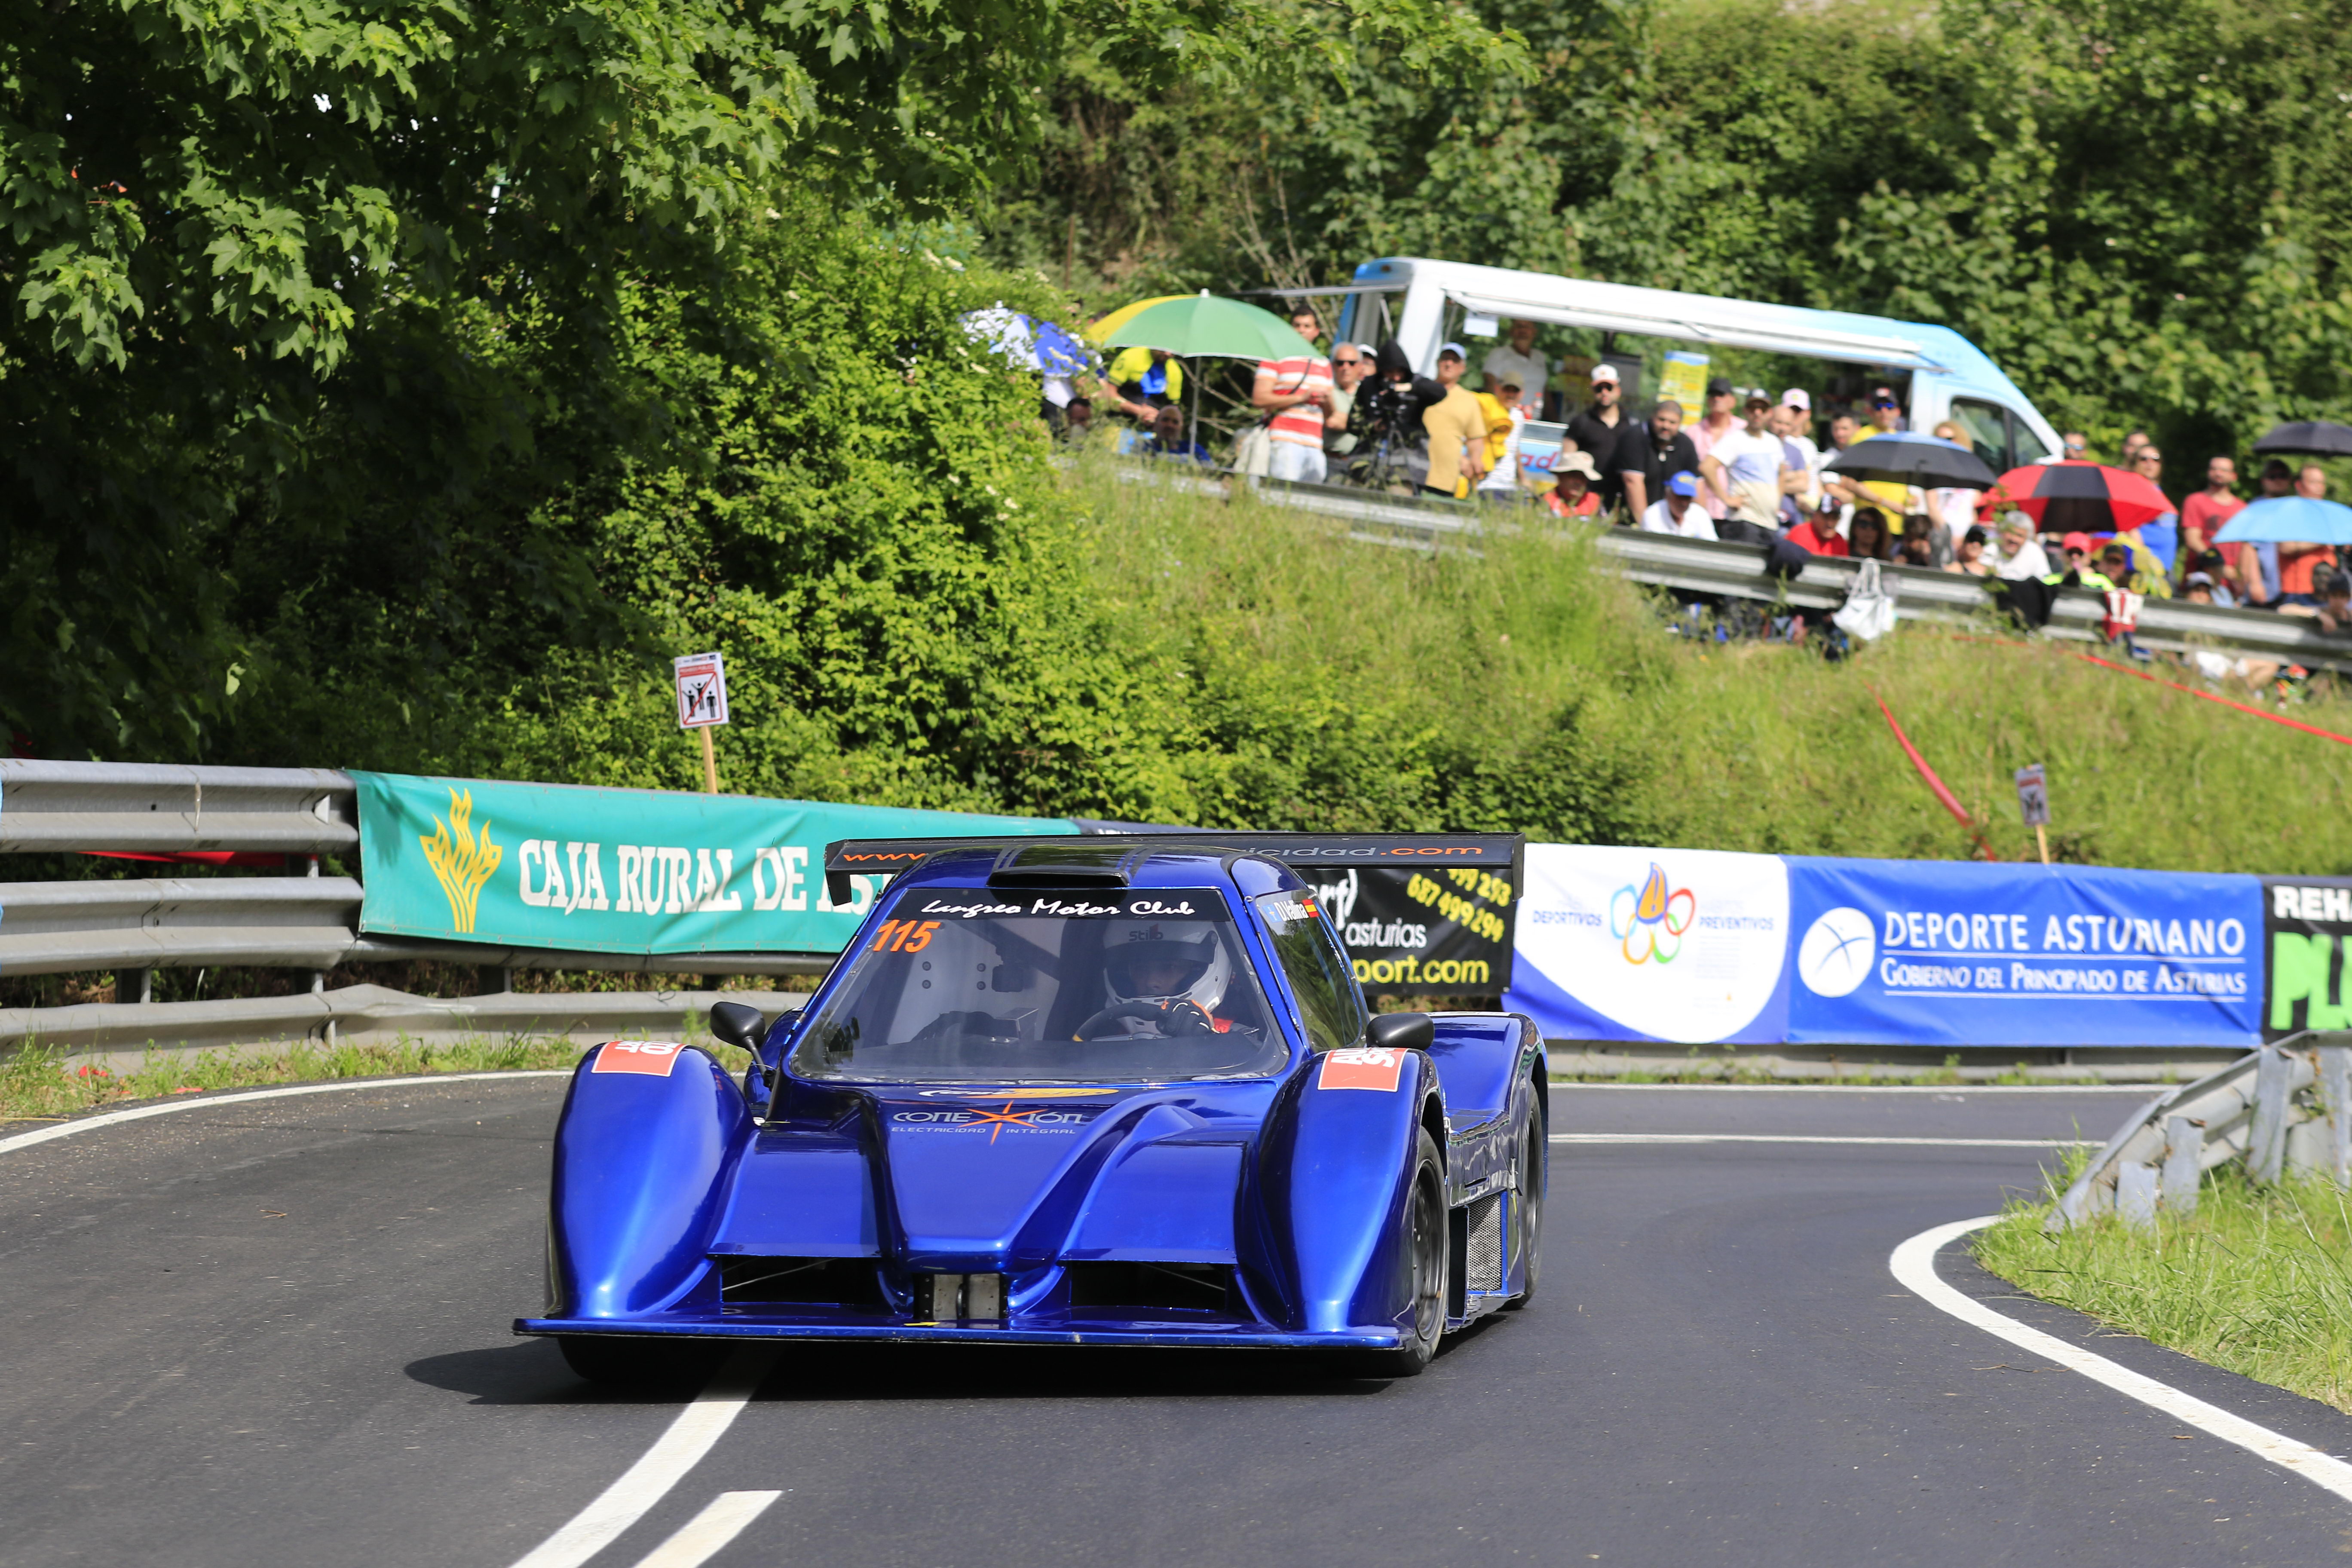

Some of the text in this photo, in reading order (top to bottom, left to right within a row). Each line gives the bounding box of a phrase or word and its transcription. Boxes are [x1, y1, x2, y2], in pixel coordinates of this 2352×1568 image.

[1244, 847, 1482, 856] icidad.com
[519, 839, 609, 916] CAJA
[616, 845, 742, 916] RURAL
[753, 846, 808, 912] DE
[1477, 872, 1512, 907] 293
[921, 898, 1196, 919] Langreo Motor Club
[1407, 873, 1505, 943] 687 499 294
[1532, 910, 1602, 927] DEPORTIVOS
[2273, 885, 2352, 922] REH
[873, 919, 941, 953] 115
[1344, 917, 1427, 948] asturias
[1699, 916, 1774, 931] PREVENTIVOS
[1883, 911, 2246, 956] DEPORTE ASTURIANO
[1880, 957, 2248, 994] GOBIERNO DEL PRINCIPADO DE ASTURIAS
